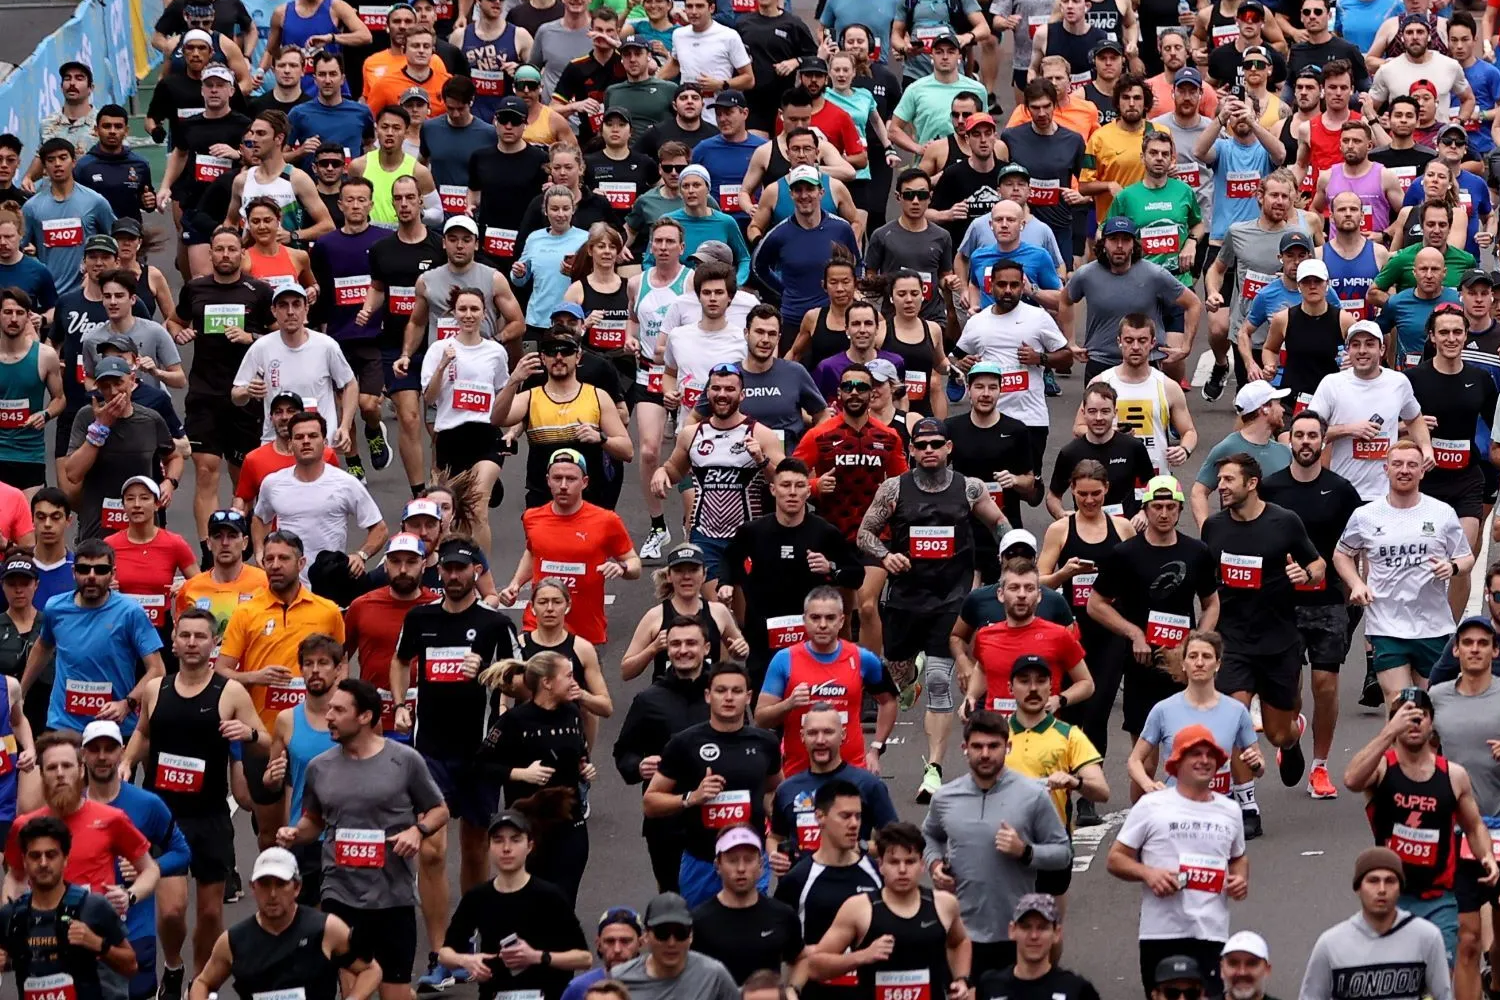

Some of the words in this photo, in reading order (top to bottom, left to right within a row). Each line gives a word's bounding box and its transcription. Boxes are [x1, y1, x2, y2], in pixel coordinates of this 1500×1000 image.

[1085, 17, 1117, 30] PMG
[466, 46, 496, 60] SYD
[475, 80, 498, 90] 7195
[1231, 181, 1257, 192] 5465
[49, 230, 77, 241] 2407
[1146, 237, 1174, 249] 3640
[418, 262, 430, 270] EY
[340, 288, 368, 299] 3858
[209, 316, 239, 328] 17161
[594, 331, 622, 342] 3852
[905, 384, 923, 393] 736
[459, 392, 486, 405] 2501
[0, 411, 23, 422] 945
[1356, 441, 1390, 452] 83377
[835, 455, 882, 466] KENYA
[1436, 452, 1463, 462] 1010
[107, 511, 129, 522] 286
[914, 528, 950, 536] CITY2SURF
[915, 540, 948, 551] 5903
[1380, 544, 1428, 556] BEACH
[1386, 556, 1422, 568] ROAD
[545, 563, 586, 573] CITY2SURF
[1226, 568, 1252, 580] 1215
[778, 632, 804, 643] 7897
[1154, 627, 1183, 640] 7568
[431, 649, 465, 658] CITY2SUR
[431, 661, 462, 674] 6827
[70, 683, 106, 691] CITY2SURF
[811, 679, 845, 697] VISION
[70, 697, 106, 707] 2420
[271, 691, 306, 704] 2409
[162, 757, 200, 769] CITY2SURF
[164, 770, 194, 784] 1633
[1393, 793, 1438, 812] SUPER
[708, 806, 743, 819] 5476
[340, 832, 379, 840] CITY2SURF
[342, 845, 377, 858] 3635
[1395, 840, 1432, 857] 7093
[1186, 870, 1217, 882] 1337
[1336, 966, 1424, 997] LONDON
[884, 989, 921, 1000] 5687
